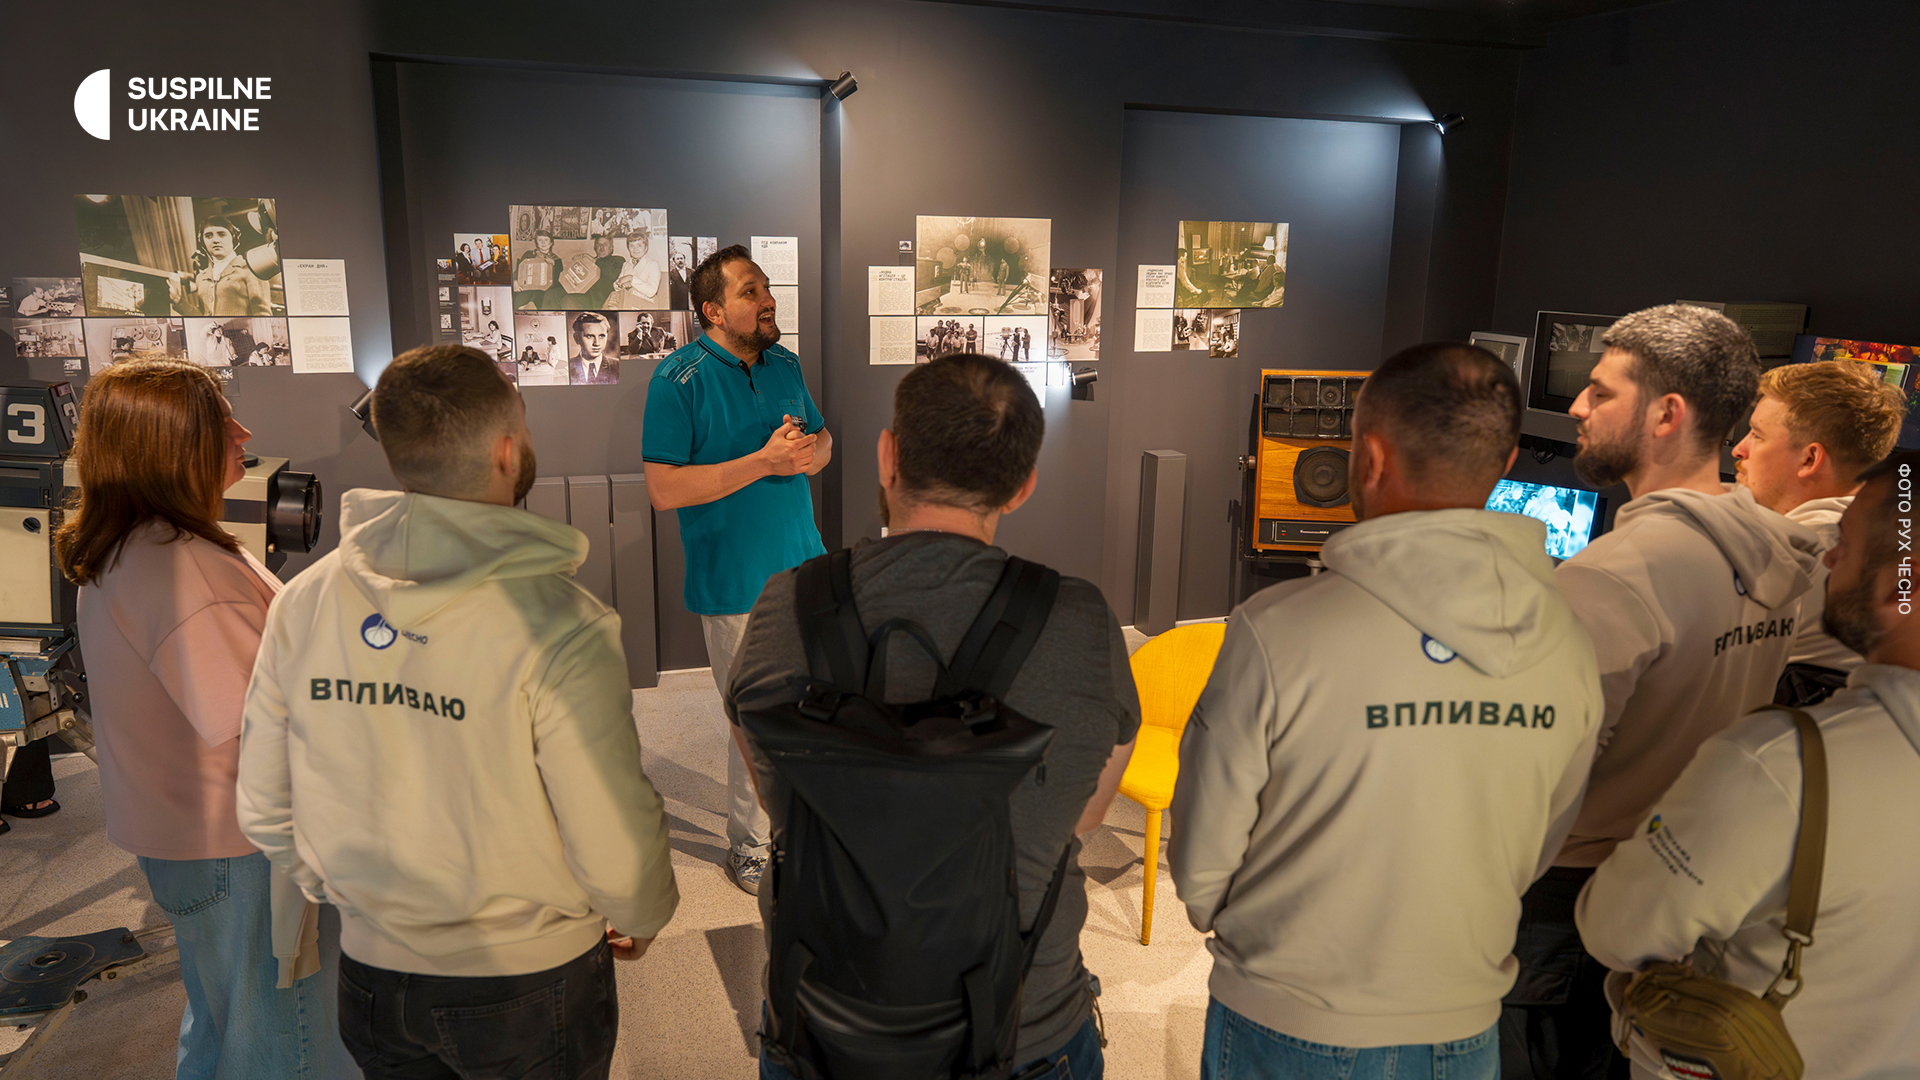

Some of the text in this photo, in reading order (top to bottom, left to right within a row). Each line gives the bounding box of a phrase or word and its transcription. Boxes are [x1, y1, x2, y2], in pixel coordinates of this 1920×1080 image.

[7, 402, 46, 445] 3
[310, 678, 466, 722] ВПЛИВАЮ
[1366, 700, 1556, 730] ВПЛИВАЮ
